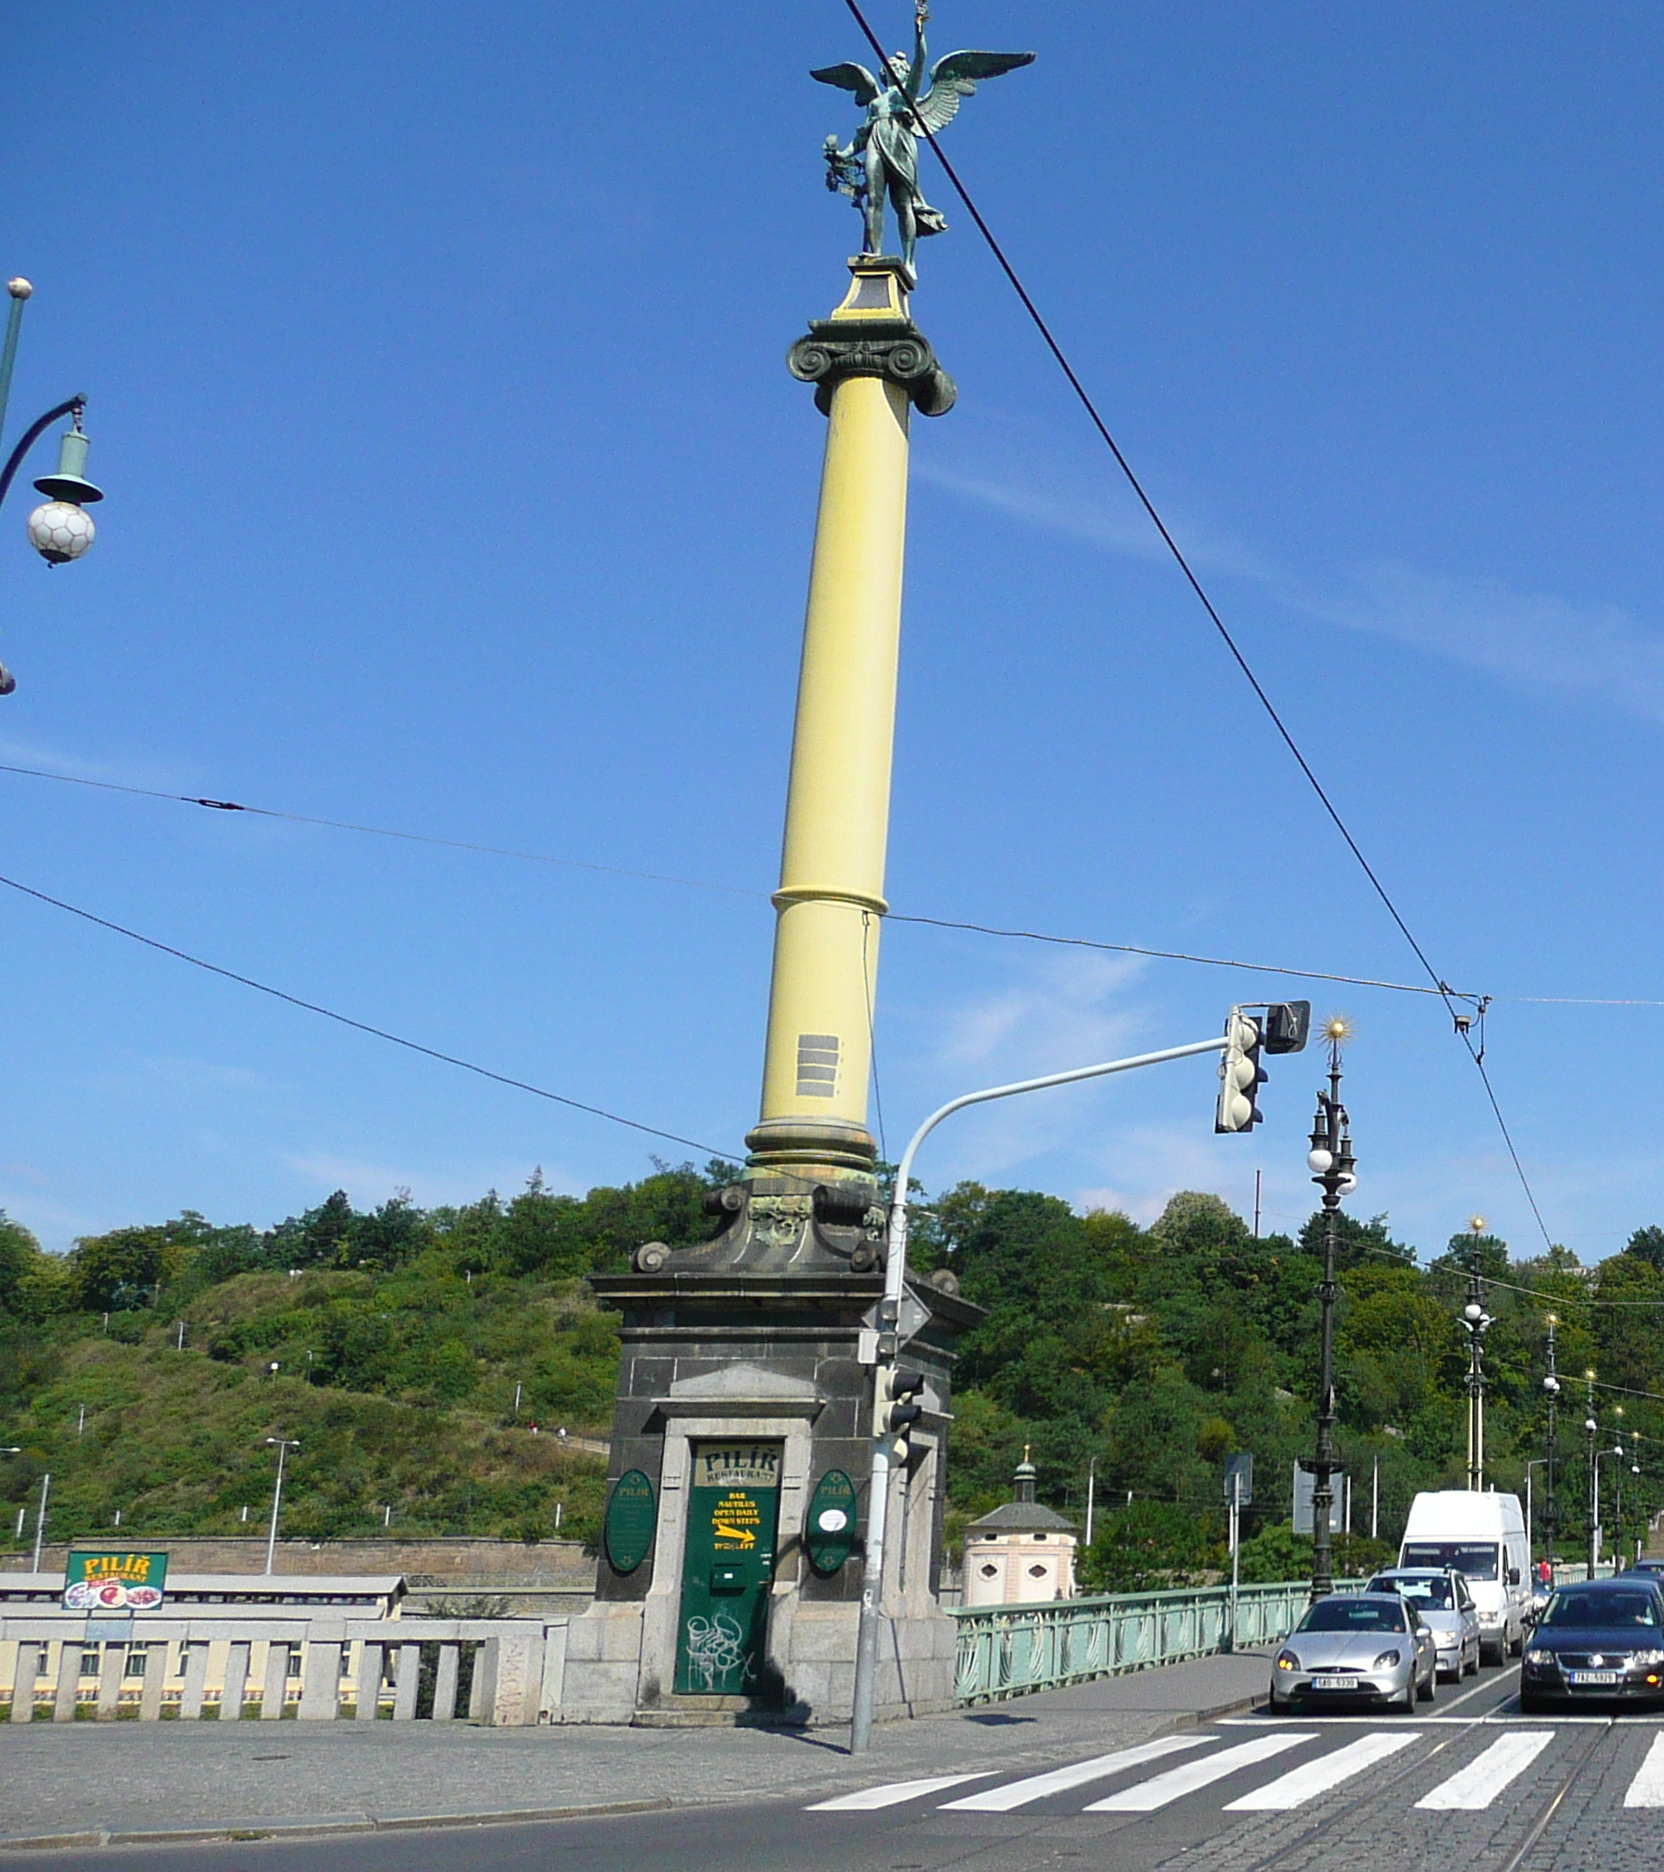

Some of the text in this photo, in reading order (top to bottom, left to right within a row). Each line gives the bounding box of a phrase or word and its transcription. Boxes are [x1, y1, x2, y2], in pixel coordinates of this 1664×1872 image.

[705, 1446, 778, 1471] PILÍŘ
[729, 1492, 746, 1500] BAR
[718, 1500, 756, 1508] NAUTILUS
[736, 1517, 760, 1525] STEPS
[84, 1554, 151, 1575] PILÍŘ
